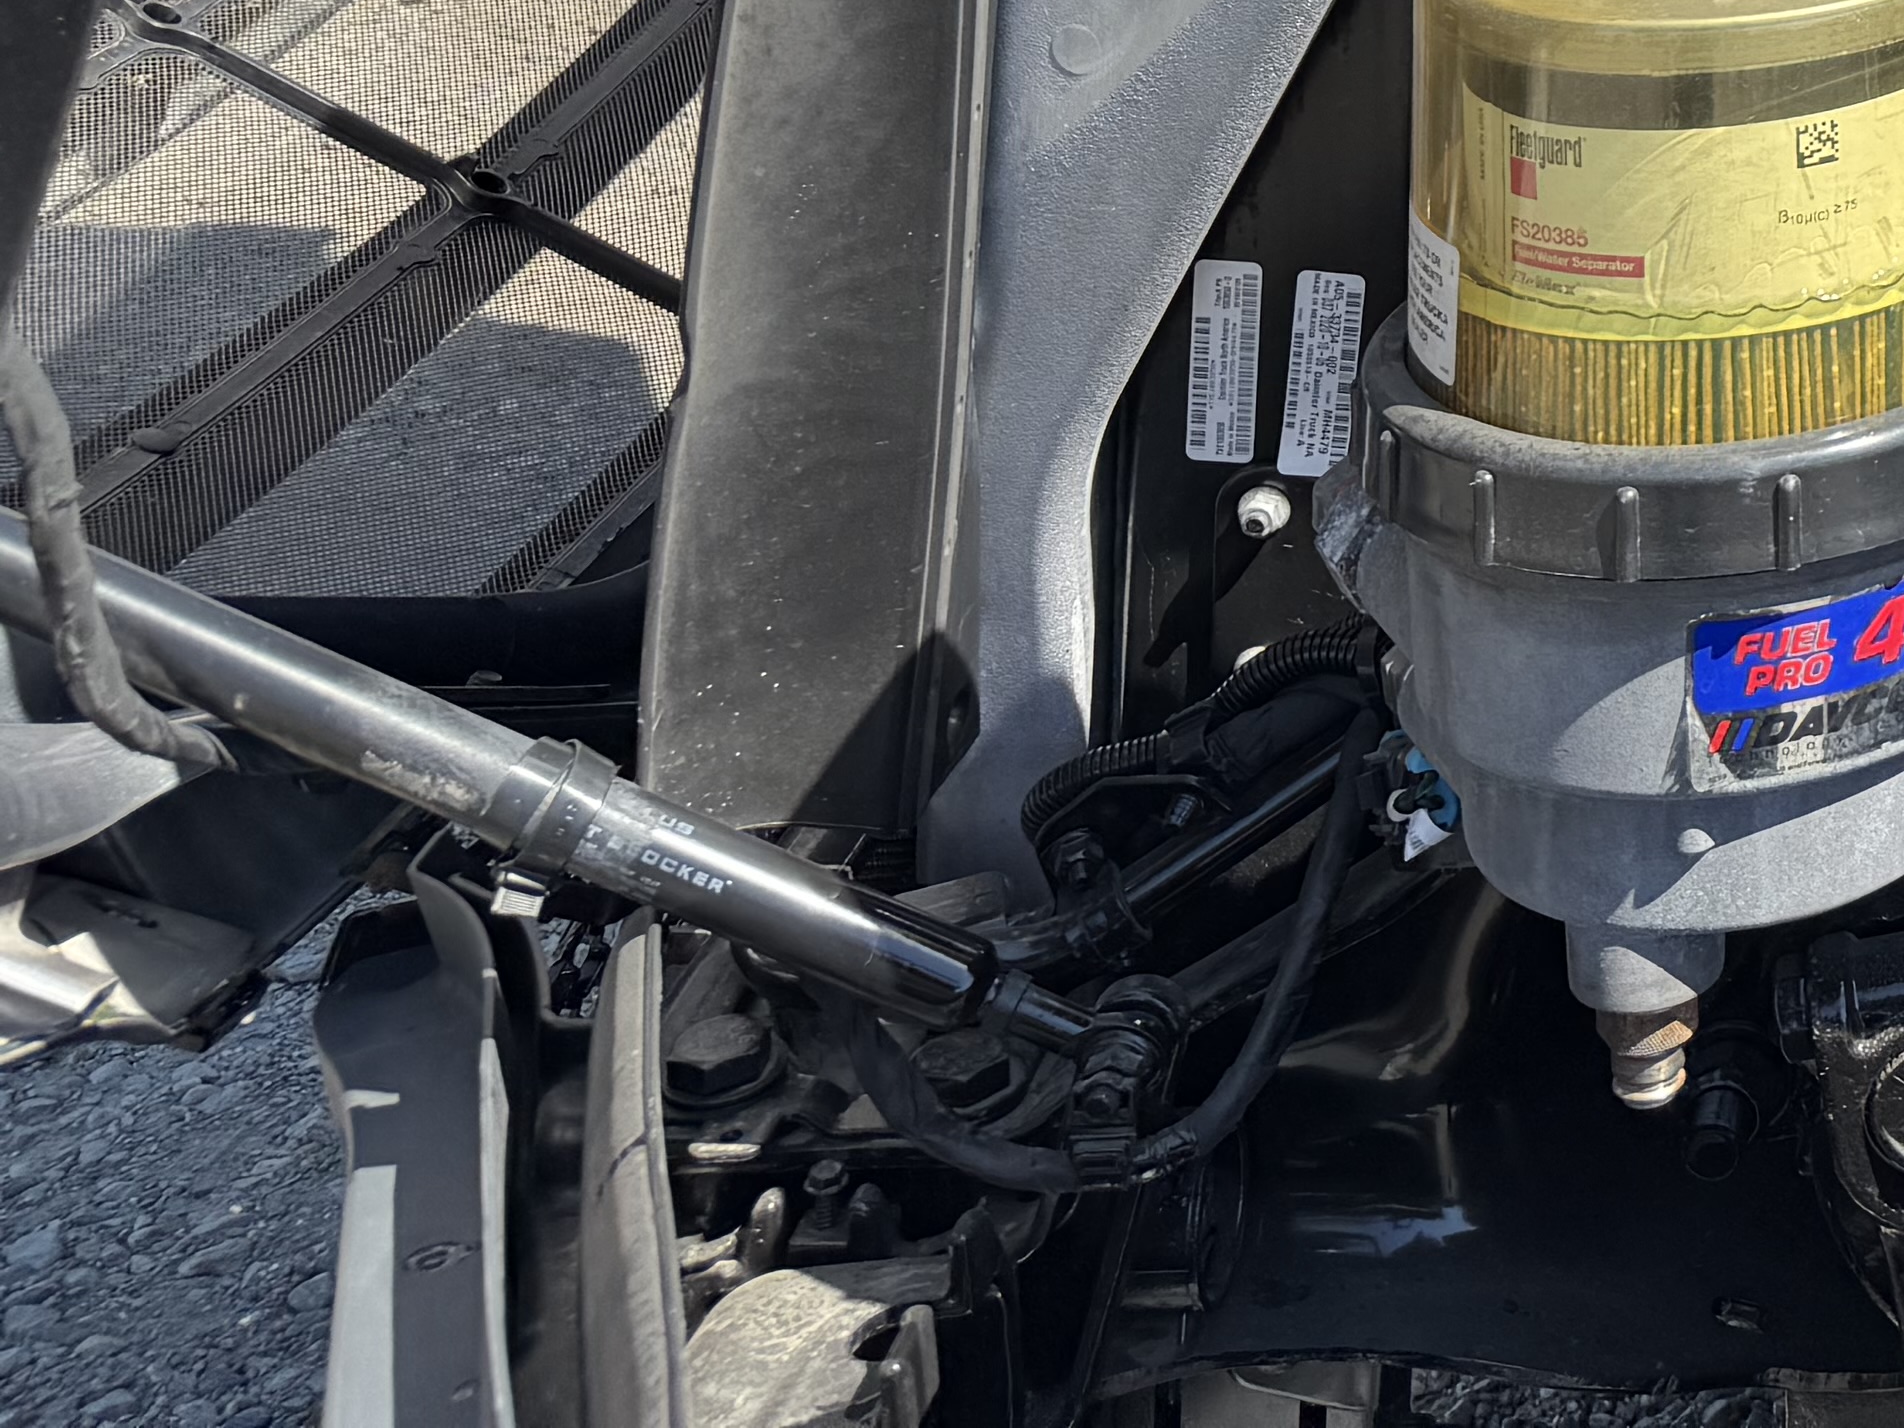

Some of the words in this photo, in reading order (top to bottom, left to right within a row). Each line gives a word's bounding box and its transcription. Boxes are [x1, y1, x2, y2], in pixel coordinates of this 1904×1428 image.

[1510, 124, 1583, 169] Fleetguard
[1511, 216, 1588, 248] FS20385
[1572, 256, 1635, 272] Separator
[1312, 272, 1322, 295] MADE
[1311, 370, 1323, 409] Daimler
[1307, 412, 1320, 440] Truck
[1318, 409, 1333, 456] MH4479
[1297, 438, 1304, 448] A
[1303, 442, 1315, 458] NA
[1734, 618, 1837, 666] FUEL
[1745, 651, 1834, 697] PRO
